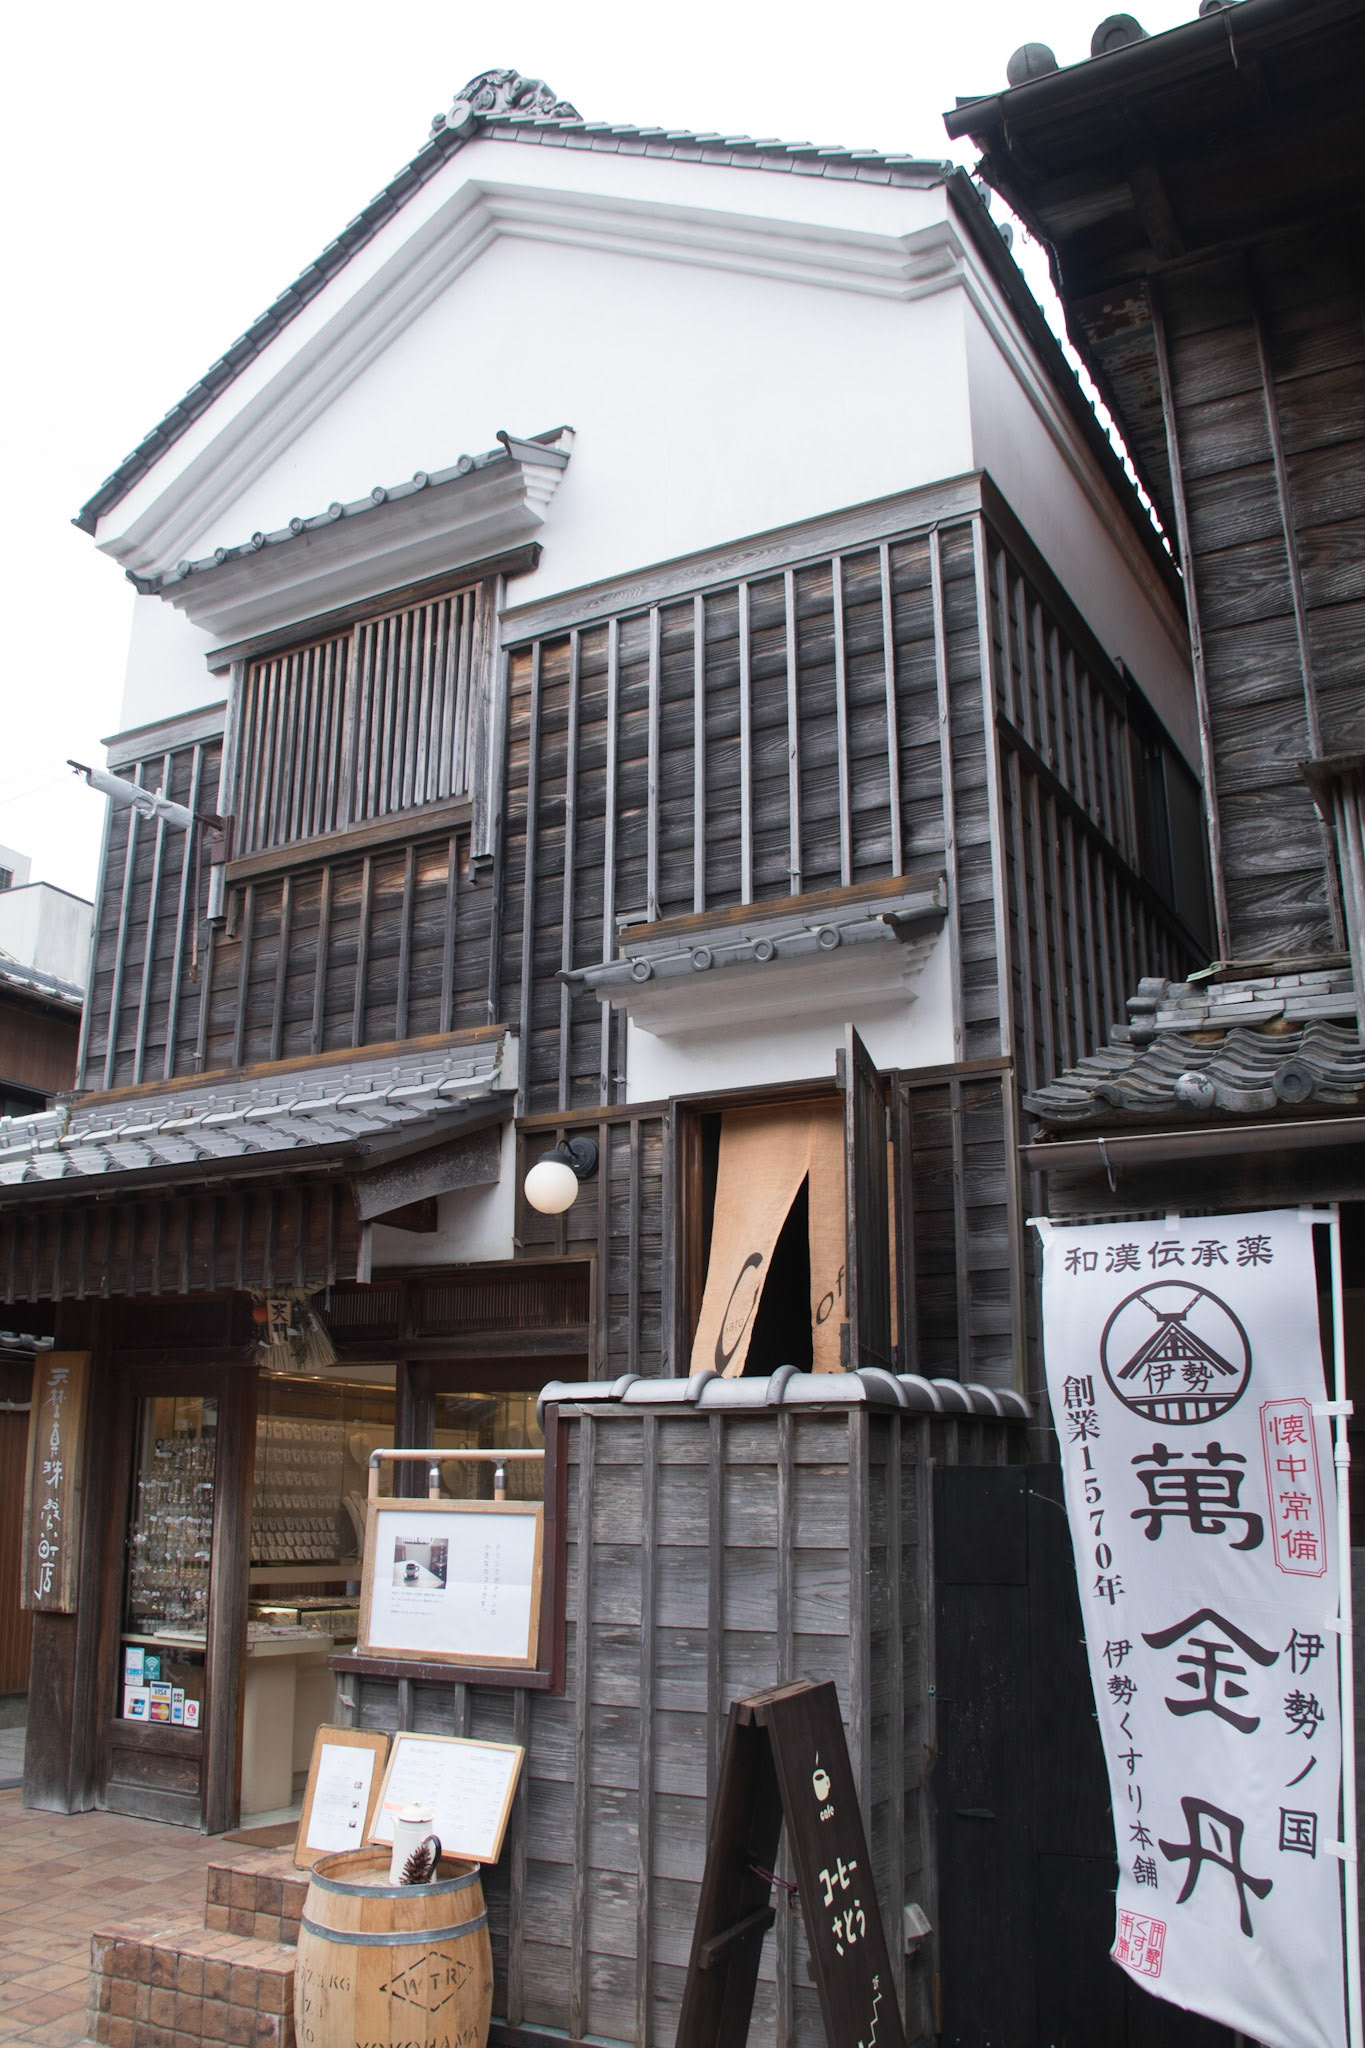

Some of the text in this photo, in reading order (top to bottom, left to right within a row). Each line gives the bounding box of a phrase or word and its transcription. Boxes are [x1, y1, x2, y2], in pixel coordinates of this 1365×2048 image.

[1065, 1234, 1274, 1276] 和漢伝承薬
[1143, 1361, 1214, 1394] 伊勢
[1269, 1413, 1320, 1562] 懐中常備
[1061, 1374, 1158, 1889] 創業1570年 伊勢くすり本舗
[154, 1688, 167, 1696] VISA
[1130, 1441, 1280, 1938] 萬金丹
[1278, 1628, 1325, 1860] 伊勢ノ国
[819, 1803, 835, 1822] cafe
[818, 1857, 858, 1907] コーヒー
[831, 1899, 866, 1957] さとう
[1130, 1920, 1149, 1968] くすり
